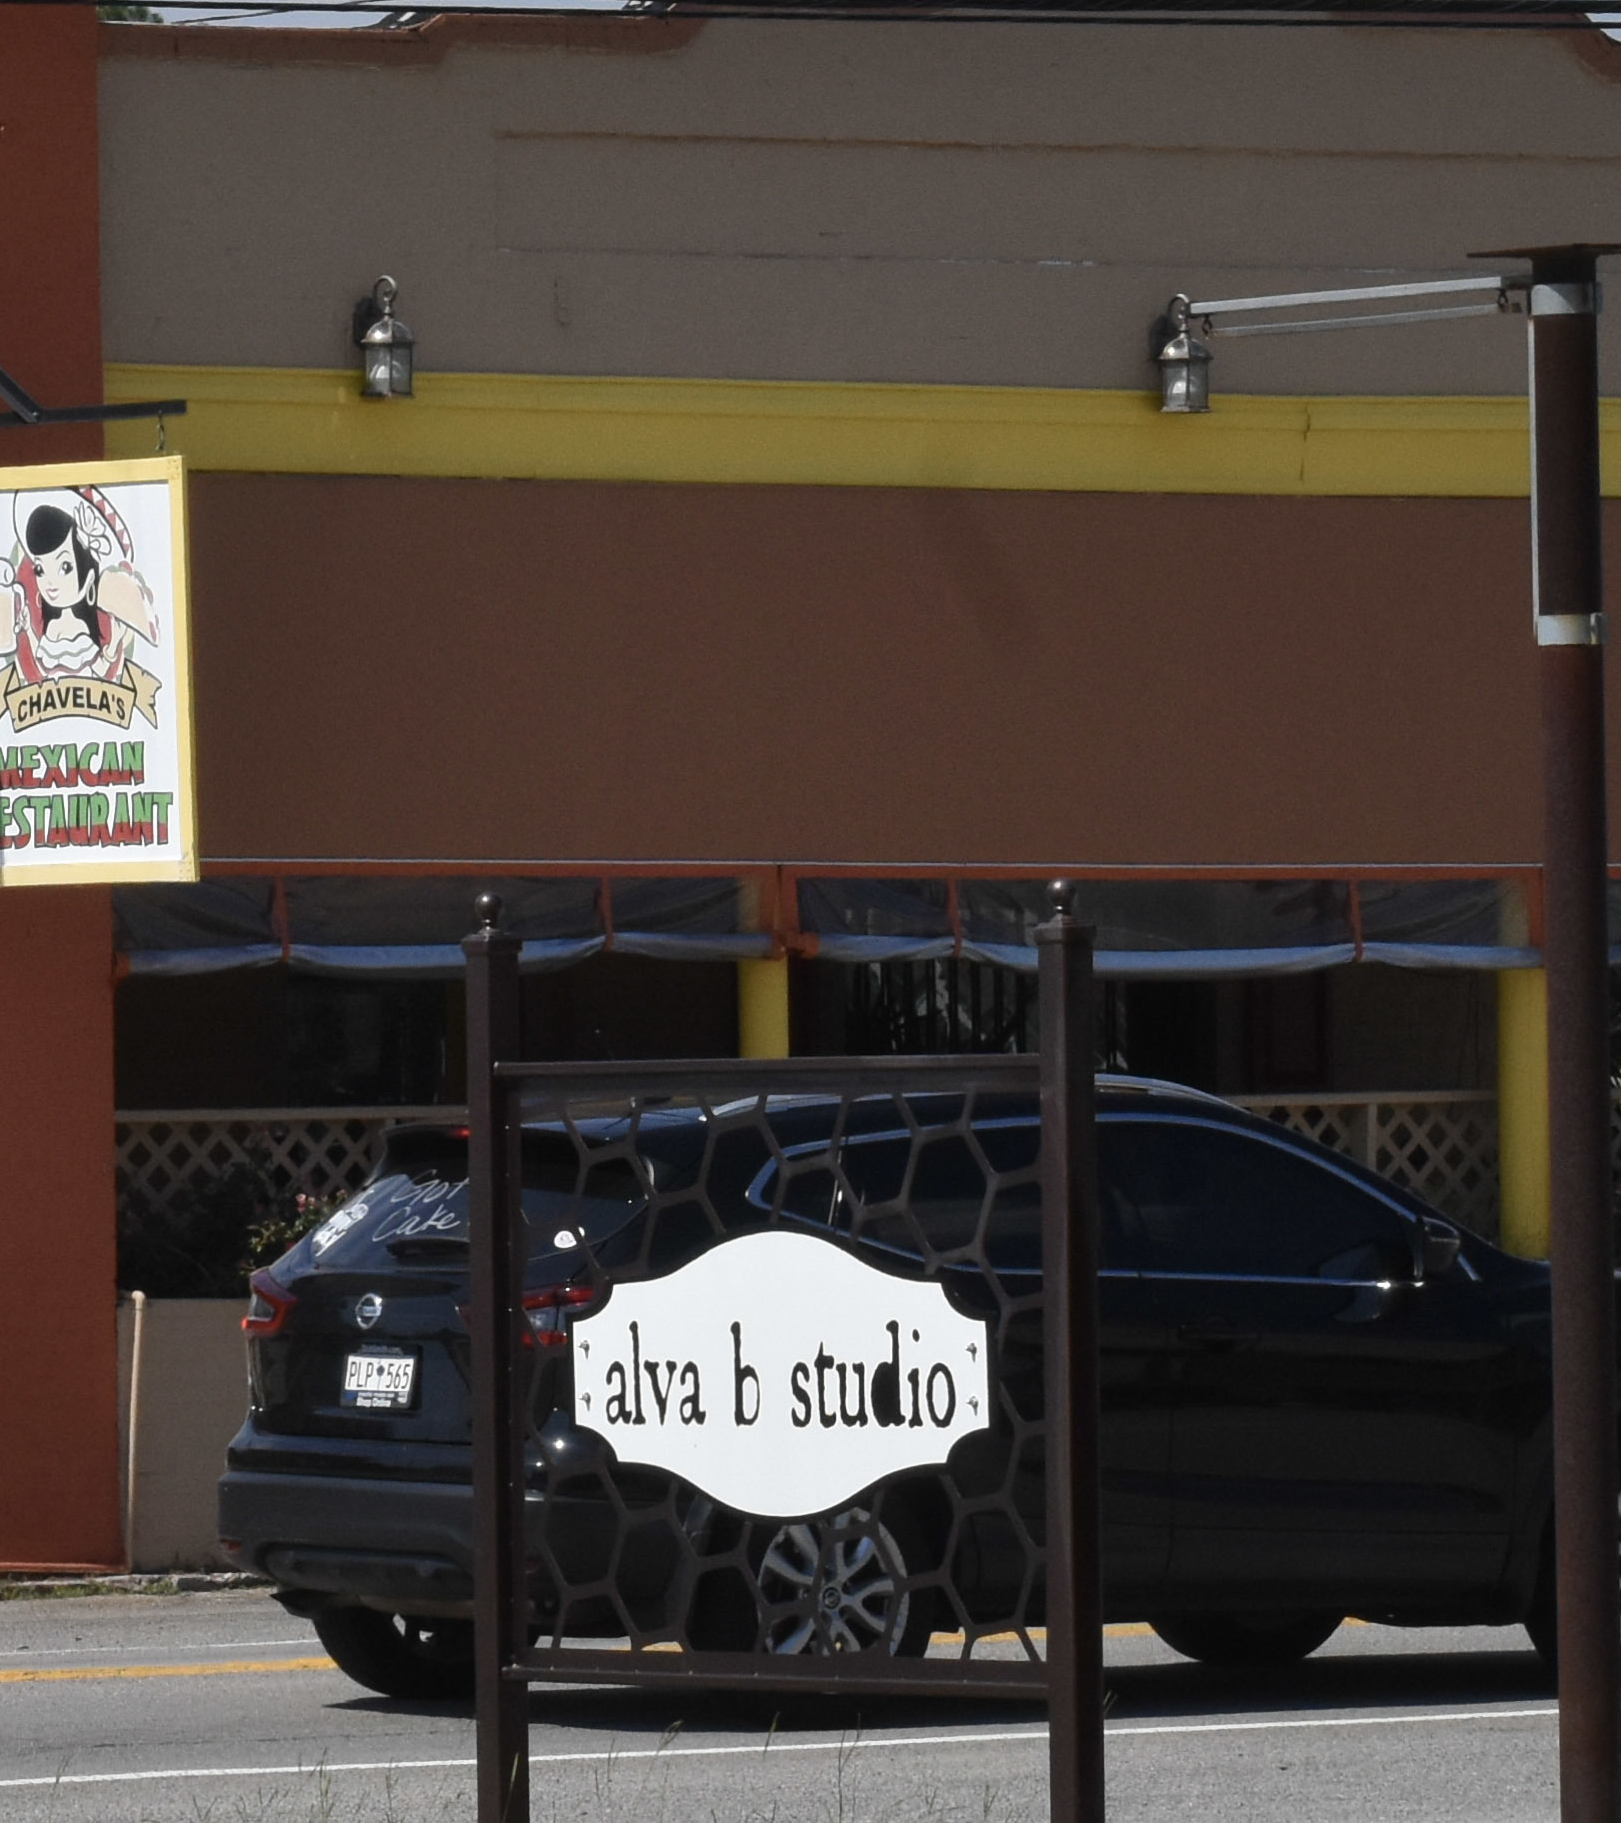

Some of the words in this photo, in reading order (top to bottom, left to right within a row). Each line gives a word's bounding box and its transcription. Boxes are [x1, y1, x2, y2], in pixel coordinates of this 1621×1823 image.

[17, 686, 127, 722] CHAVELA'S
[372, 1203, 461, 1242] Cake
[347, 1361, 375, 1389] PLP
[385, 1363, 412, 1390] 565
[605, 1320, 707, 1426] alva
[730, 1321, 761, 1427] b
[790, 1320, 957, 1429] studio
